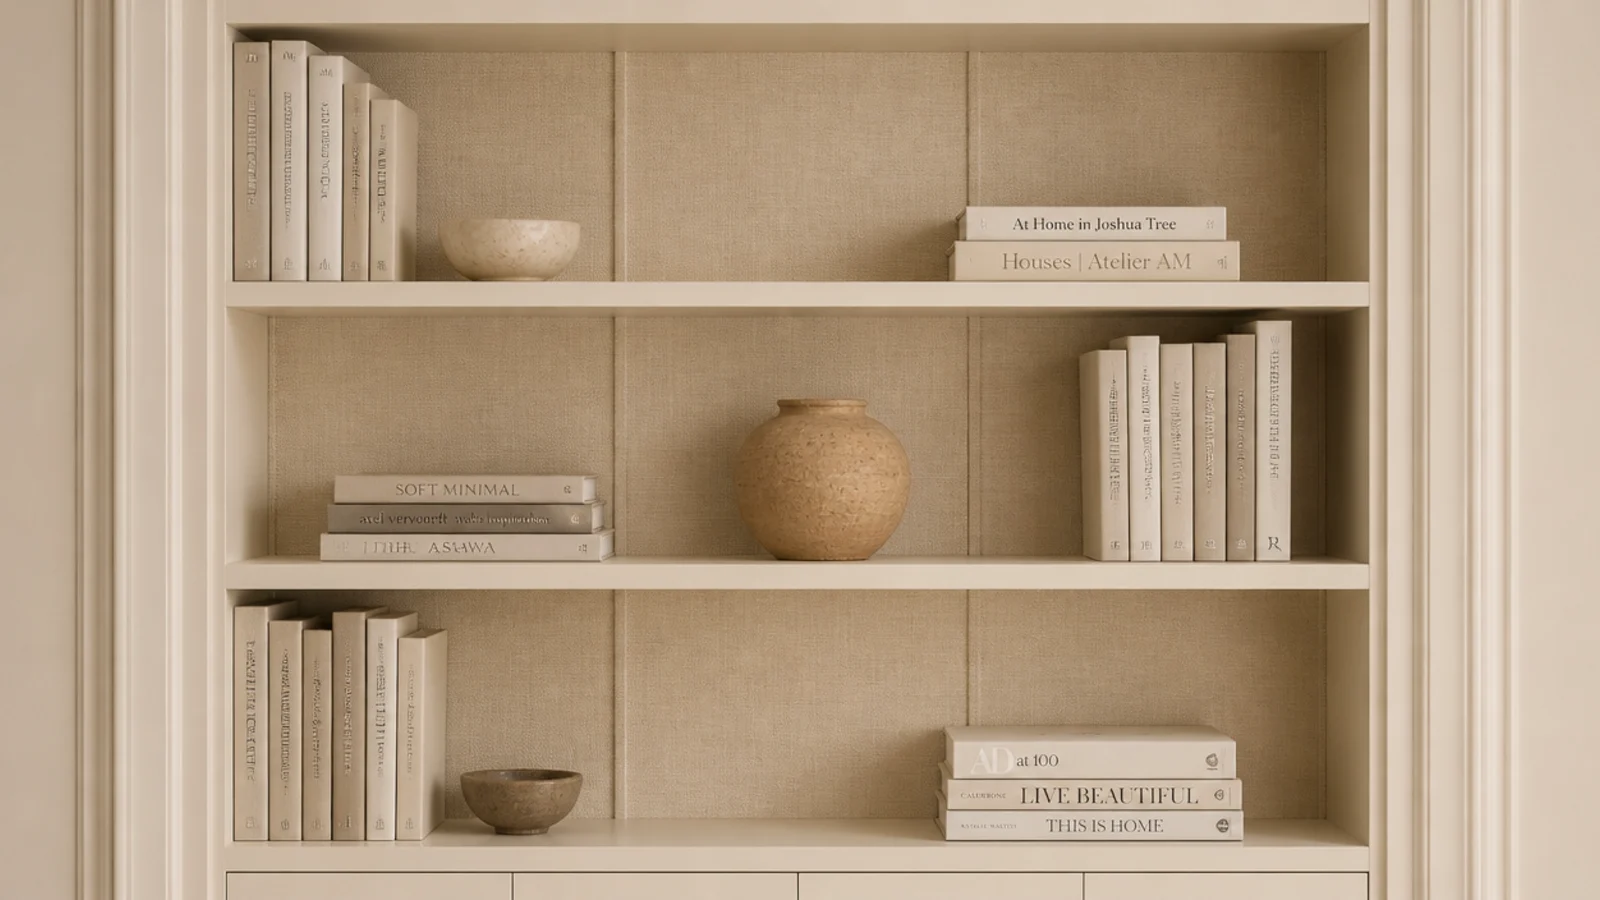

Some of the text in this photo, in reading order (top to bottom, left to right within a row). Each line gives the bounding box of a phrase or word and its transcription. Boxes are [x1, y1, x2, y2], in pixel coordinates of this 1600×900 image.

[1012, 216, 1178, 232] At Home in Joshua Tree
[1002, 252, 1071, 271] Houses
[1087, 252, 1152, 271] Atelier
[1156, 252, 1192, 271] AM
[395, 483, 519, 497] SOFT MINIMAL
[1267, 536, 1283, 552] R
[970, 746, 1060, 775] AD at 100
[1020, 786, 1199, 805] LIVE BEAUTIFUL
[1046, 818, 1164, 833] THIS IS HOME
